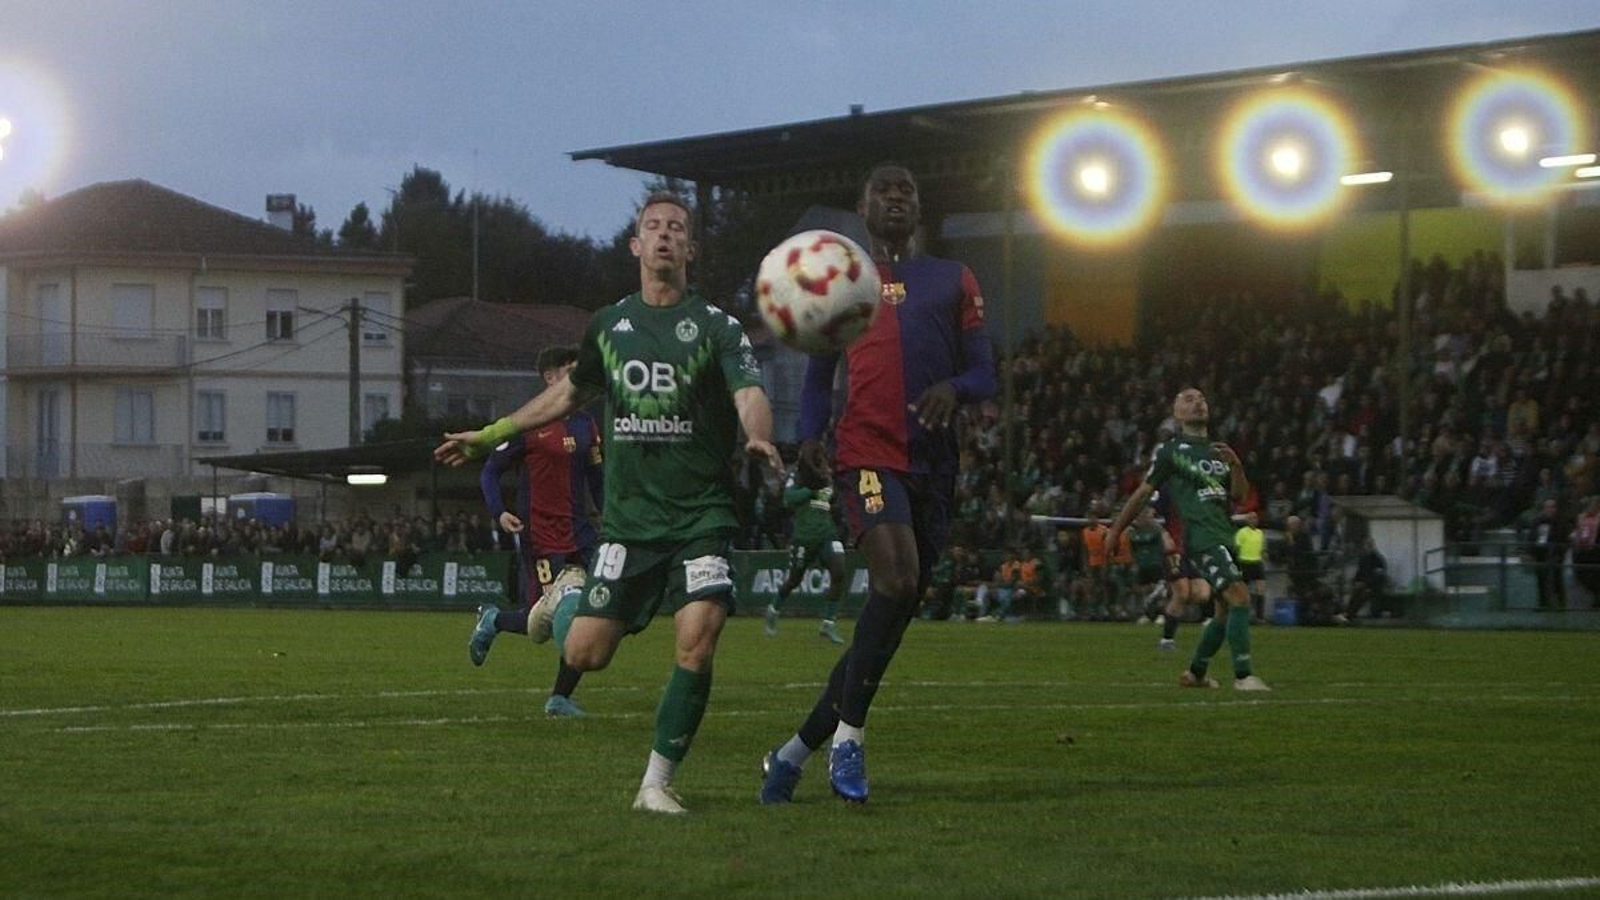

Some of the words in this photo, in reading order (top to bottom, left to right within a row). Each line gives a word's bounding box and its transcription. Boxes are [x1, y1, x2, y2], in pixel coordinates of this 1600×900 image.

[623, 359, 677, 393] OB
[614, 413, 693, 433] columbia
[1198, 459, 1226, 475] OB
[859, 469, 882, 495] 4
[537, 558, 552, 584] 8
[594, 542, 627, 581] 19
